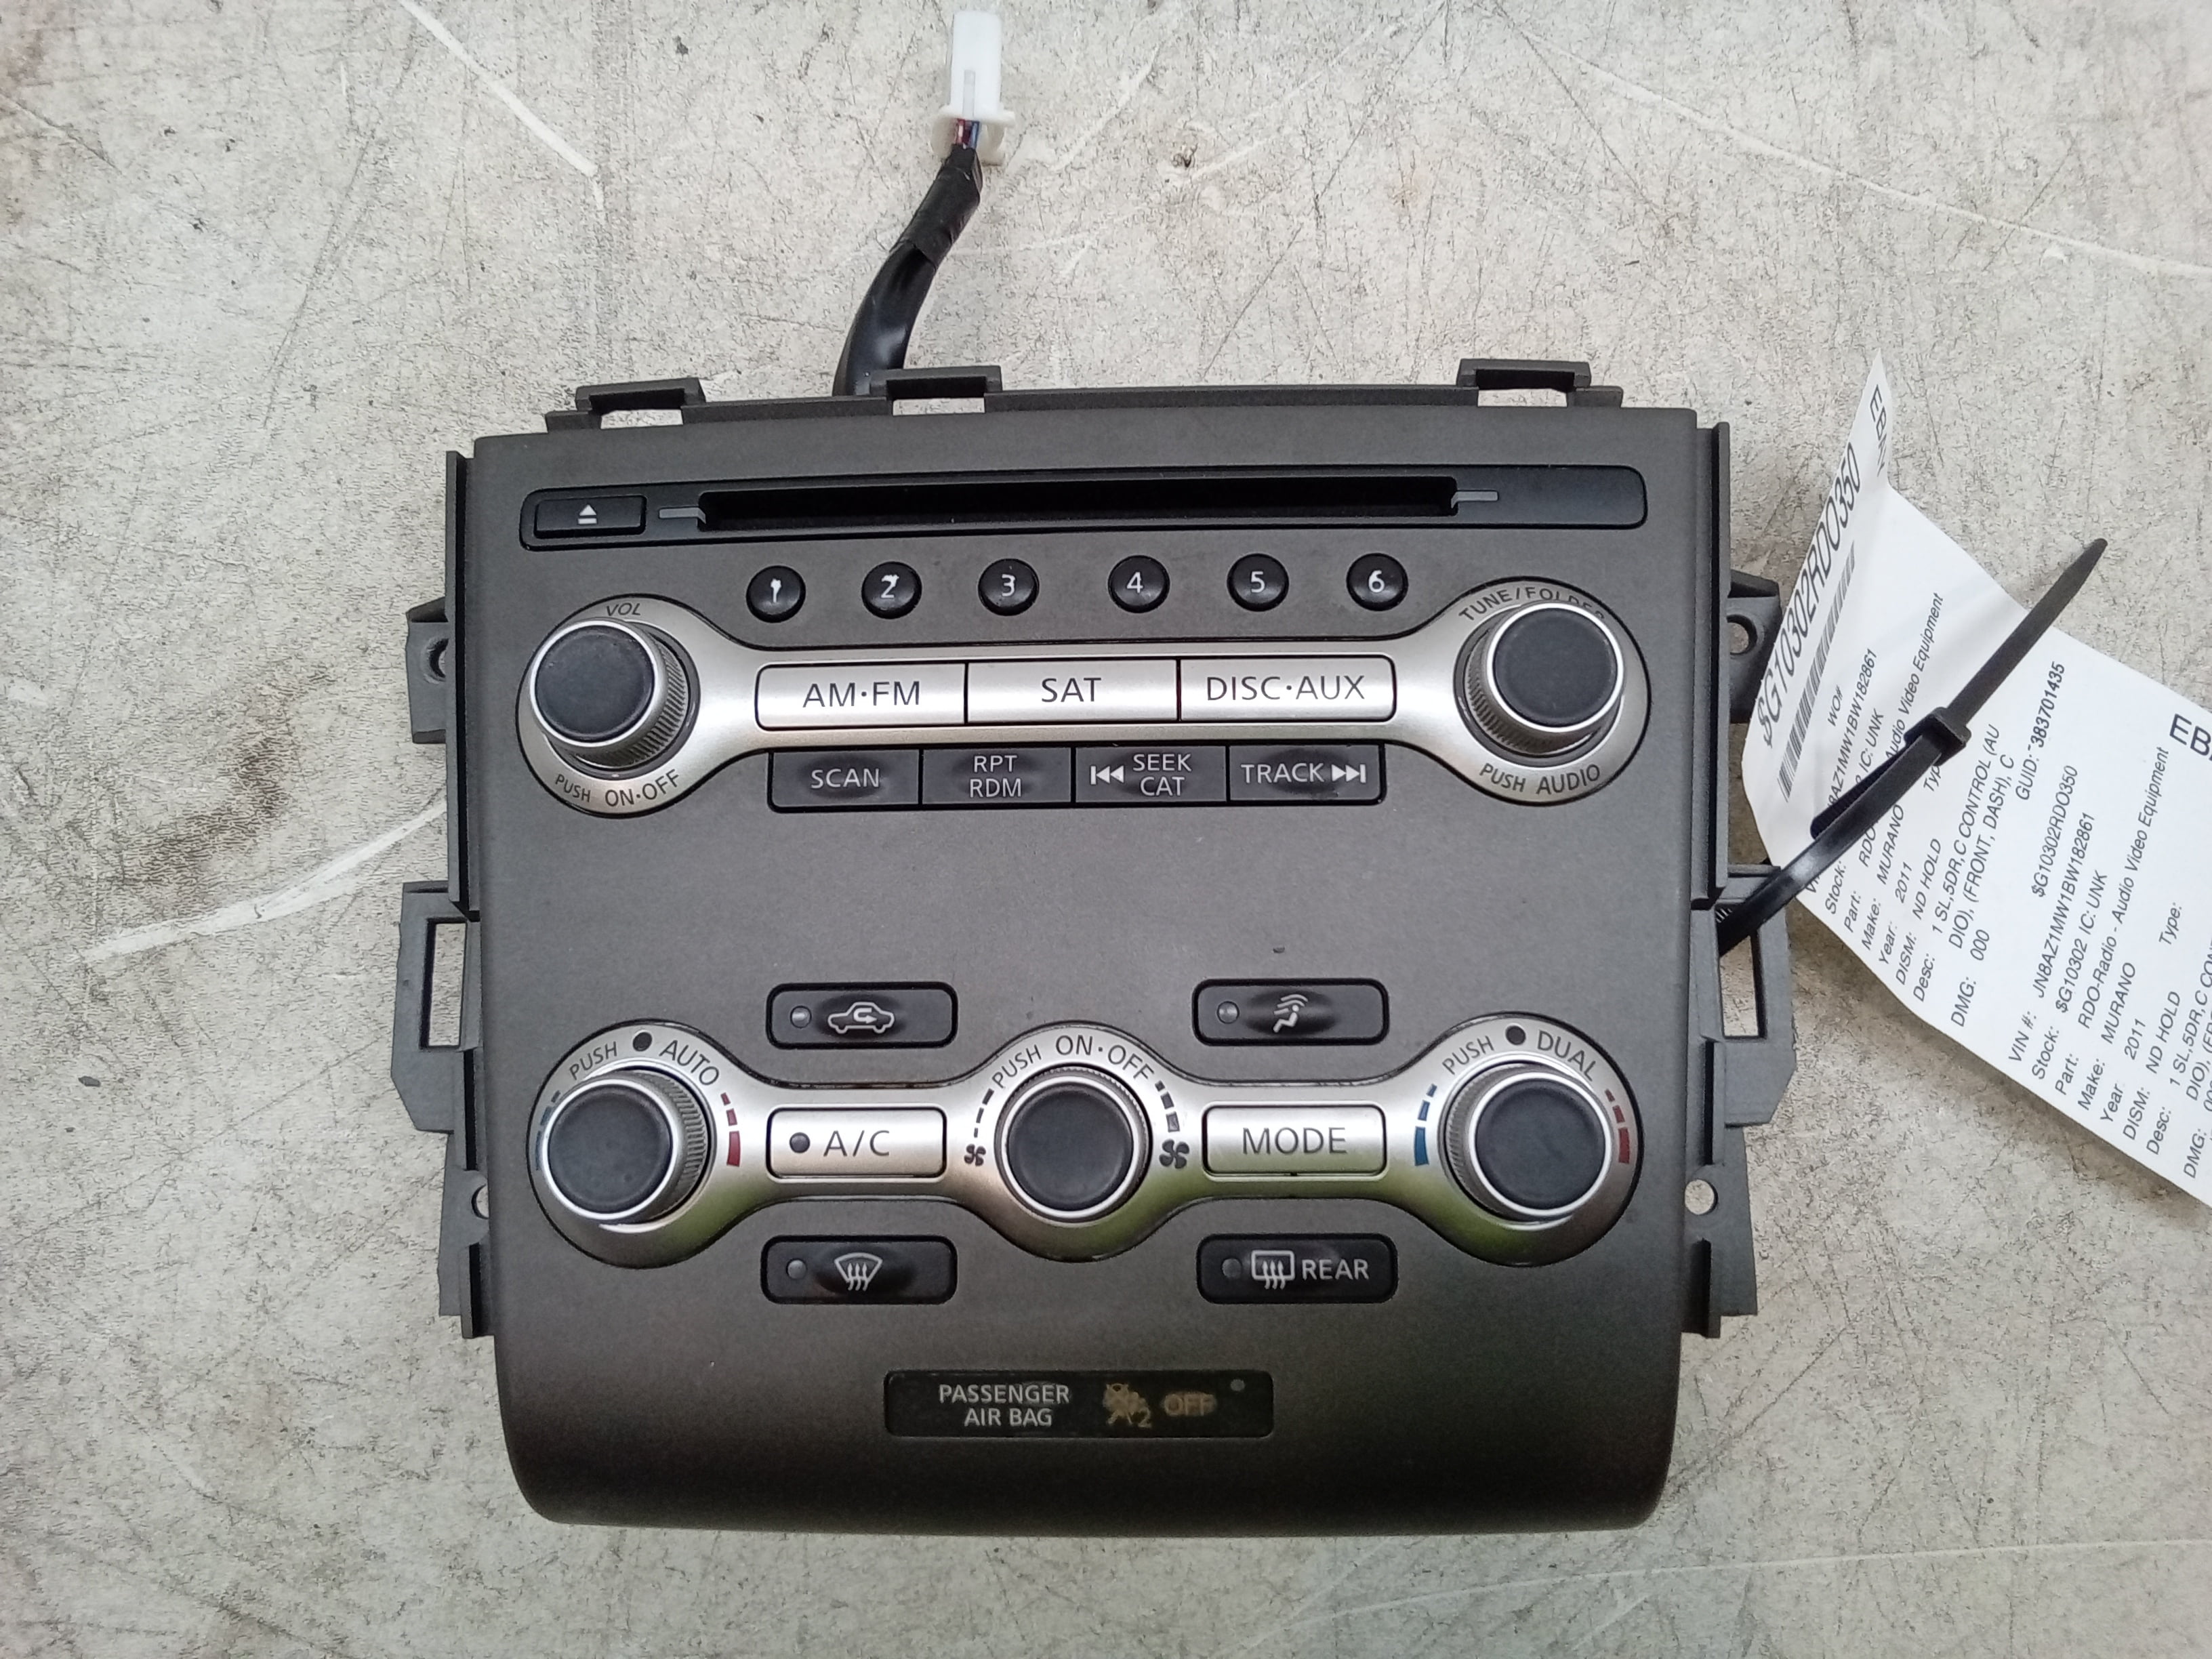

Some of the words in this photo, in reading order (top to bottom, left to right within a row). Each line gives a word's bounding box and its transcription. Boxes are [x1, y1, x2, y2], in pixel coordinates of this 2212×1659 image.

[881, 574, 900, 598] 2
[1000, 574, 1016, 597] 3
[1126, 571, 1144, 594] 4
[1250, 570, 1266, 594] 5
[1368, 570, 1385, 594] 6
[606, 602, 641, 617] VOL
[1040, 677, 1102, 703] SAT
[1865, 708, 1885, 748] UNK
[2169, 713, 2212, 762] EB
[809, 767, 881, 790] SCAN
[972, 754, 1018, 774] RPT
[1132, 752, 1193, 773] SEEK
[1240, 762, 1325, 784] TRACK
[1843, 890, 1862, 933] Part:
[1898, 672, 1921, 715] Video
[1912, 592, 1944, 673] Equipment
[1999, 754, 2015, 770] C
[554, 773, 592, 804] PUSH
[968, 777, 1023, 799] RDM
[1139, 776, 1185, 797] CAT
[1479, 762, 1526, 793] PUSH
[1535, 763, 1601, 796] AUDIO
[1861, 897, 1881, 951] Make:
[1876, 804, 1904, 886] MURANO
[1912, 953, 1936, 1002] Desc:
[1959, 760, 1991, 839] CONTROL
[1982, 723, 2000, 756] (AU
[1824, 860, 1847, 915] Stock:
[1950, 976, 1977, 1027] DMG:
[2015, 753, 2040, 801] GUID:
[2085, 869, 2108, 909] UNK
[1878, 920, 1898, 965] Year:
[1894, 861, 1913, 904] 2011
[1896, 931, 1917, 986] DISM:
[1911, 890, 1927, 920] ND
[1919, 838, 1942, 890] HOLD
[2054, 1052, 2080, 1096] Part:
[2077, 935, 2117, 1030] RDO-Radio
[2111, 877, 2135, 924] Audio
[2124, 829, 2148, 872] Video
[2137, 746, 2169, 828] Equipment
[2078, 909, 2097, 936] IC:
[2055, 938, 2088, 1014] $G10302
[2077, 1058, 2106, 1111] Make:
[2100, 962, 2136, 1045] MURANO
[2158, 901, 2183, 946] Type:
[1441, 1035, 1495, 1076] PUSH
[1537, 1029, 1600, 1082] DUAL
[2008, 1030, 2030, 1063] VIN
[2031, 1025, 2060, 1080] Stock:
[2124, 1018, 2146, 1061] 2011
[569, 1040, 619, 1082] PUSH
[658, 1038, 720, 1087] AUTO
[991, 1044, 1042, 1089] PUSH
[2123, 1086, 2151, 1141] DISM:
[2146, 1045, 2163, 1074] ND
[2155, 990, 2181, 1044] HOLD
[823, 1129, 891, 1158] A/C
[1242, 1126, 1348, 1155] MODE
[2146, 1105, 2172, 1155] Desc:
[2182, 1128, 2207, 1179] DMG:
[1301, 1259, 1370, 1281] REAR
[938, 1383, 1070, 1405] PASSENGER
[1163, 1392, 1217, 1416] OFF
[964, 1408, 1002, 1427] AIR
[1009, 1408, 1052, 1427] BAG
